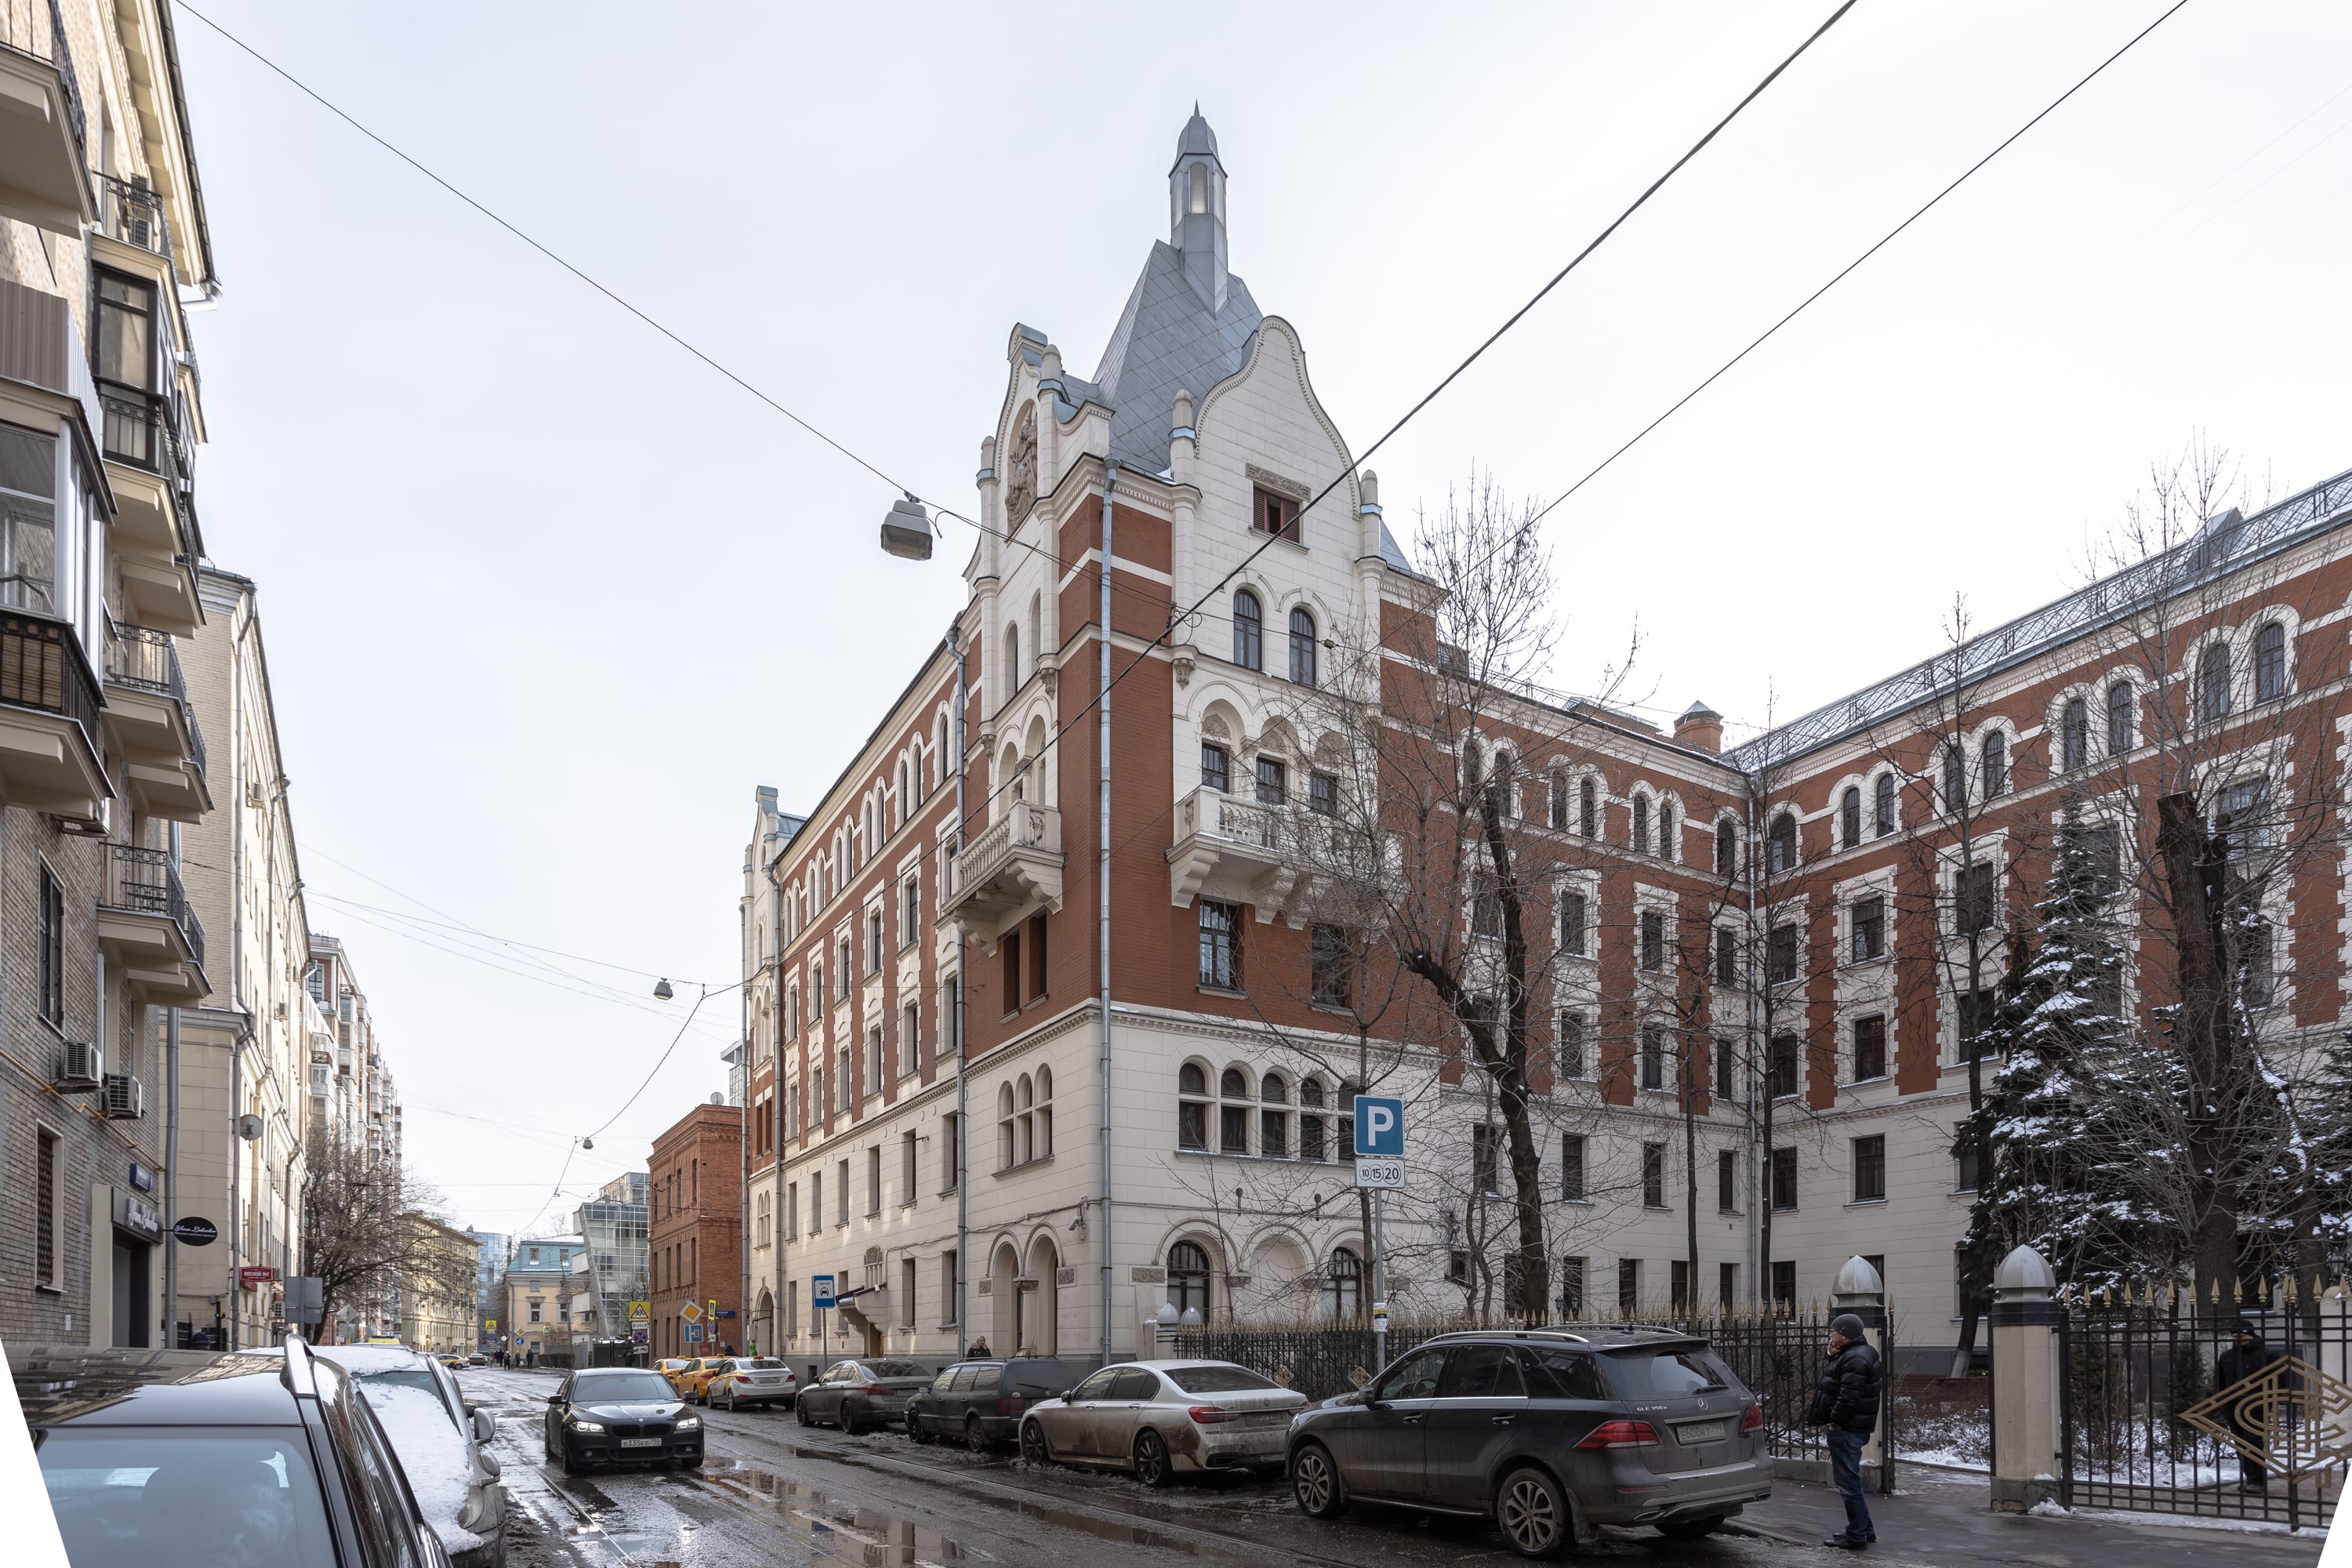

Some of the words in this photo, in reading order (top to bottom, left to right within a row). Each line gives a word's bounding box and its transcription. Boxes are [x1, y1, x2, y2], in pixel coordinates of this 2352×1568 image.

[1367, 1105, 1394, 1146] P
[1362, 1169, 1370, 1178] 10
[1372, 1168, 1381, 1178] 15
[1385, 1167, 1399, 1180] 20
